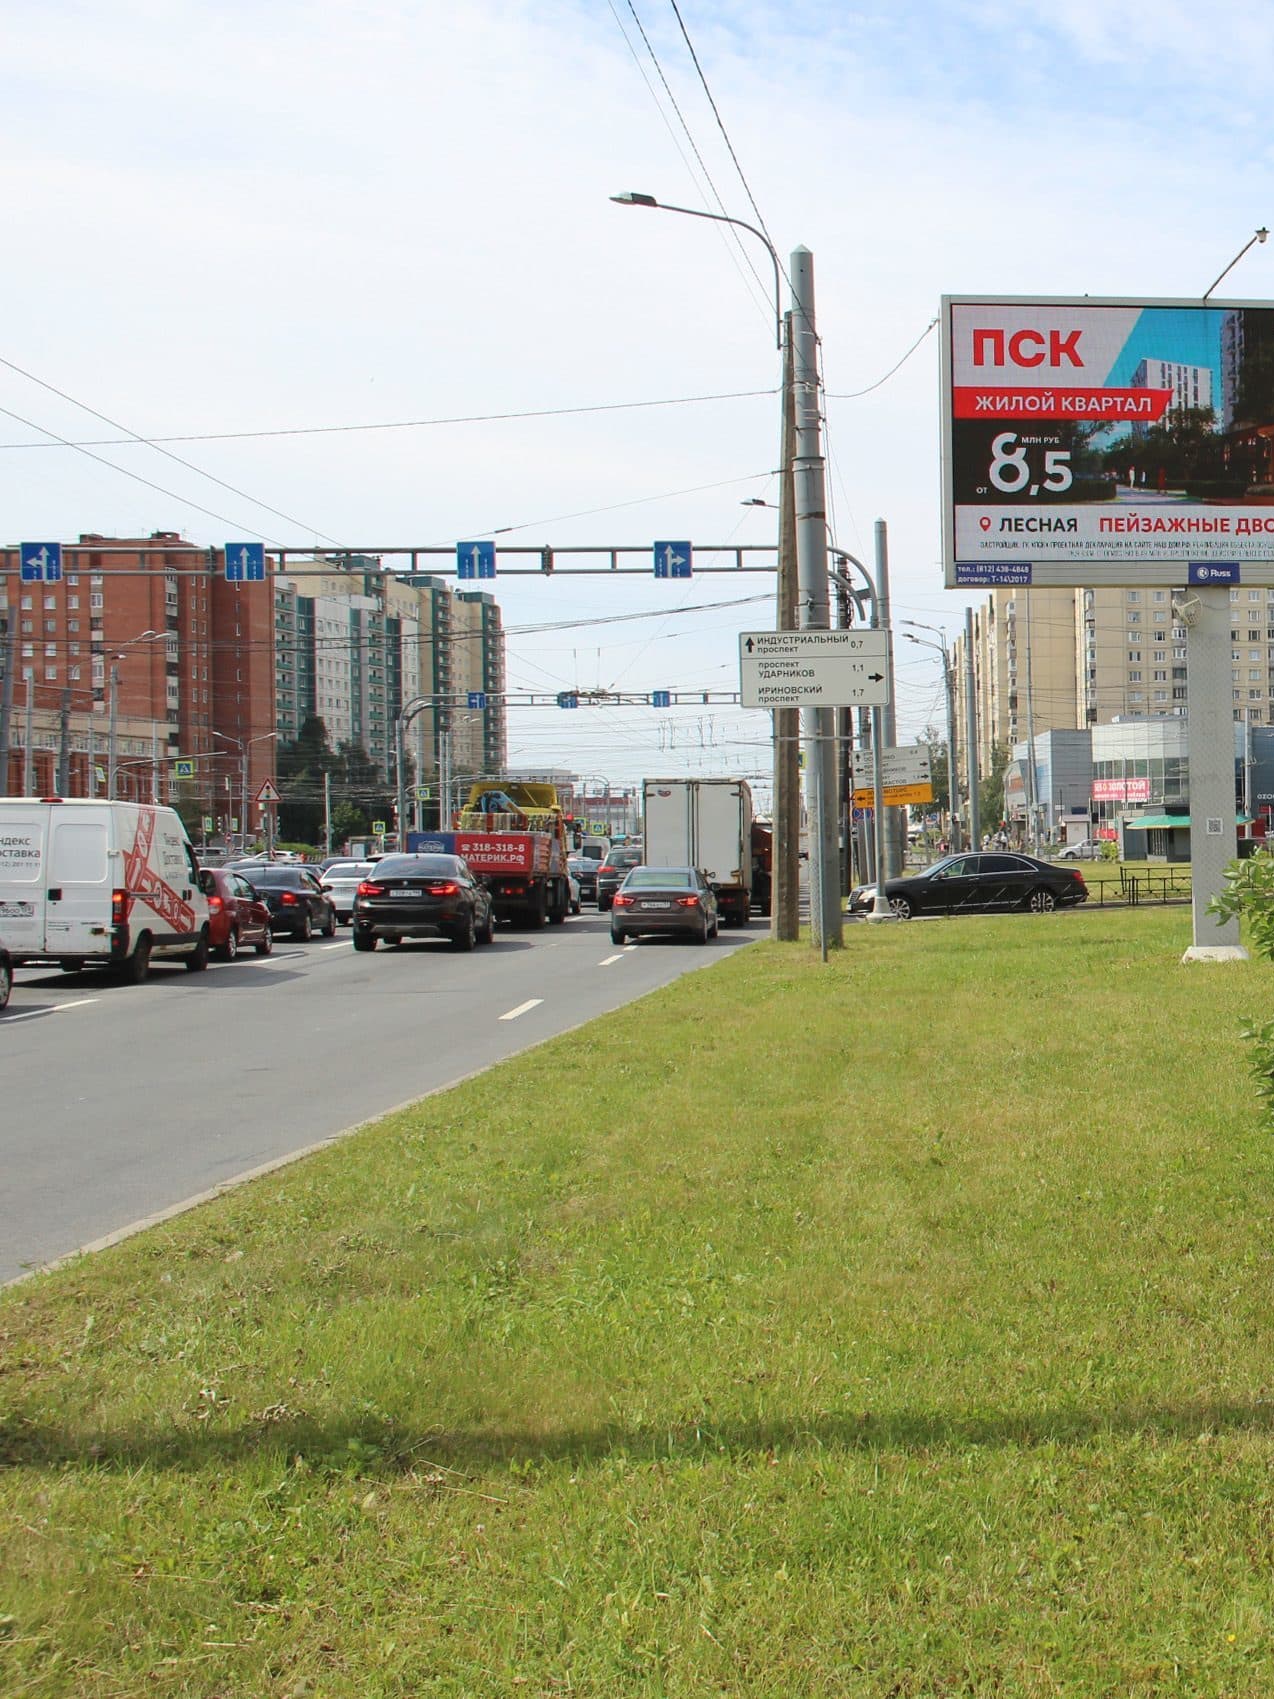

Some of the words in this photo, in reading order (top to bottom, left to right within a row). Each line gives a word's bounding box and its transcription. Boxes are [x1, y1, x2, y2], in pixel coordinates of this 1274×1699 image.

[973, 329, 1085, 368] ПСК
[975, 391, 1055, 412] ЖИЛОЙ
[1061, 397, 1151, 412] КВАРТАЛ
[989, 432, 1073, 496] 8,5
[999, 517, 1078, 532] ЛЕСНАЯ
[1099, 512, 1231, 533] ПЕЙЗАЖНЫЕ
[1210, 569, 1231, 578] Russ
[757, 634, 849, 645] ИНДУСТРИАЛЬНЫЙ
[850, 640, 864, 649] 0,7
[757, 646, 799, 654] проспект
[758, 661, 800, 669] проспект
[758, 670, 815, 679] УДАРНИКОВ
[758, 684, 822, 695] ИРИНОВСКИЙ
[758, 695, 800, 703] проспект
[0, 837, 32, 846] ндекс
[472, 843, 525, 852] 318-318-8
[0, 849, 41, 858] ставка
